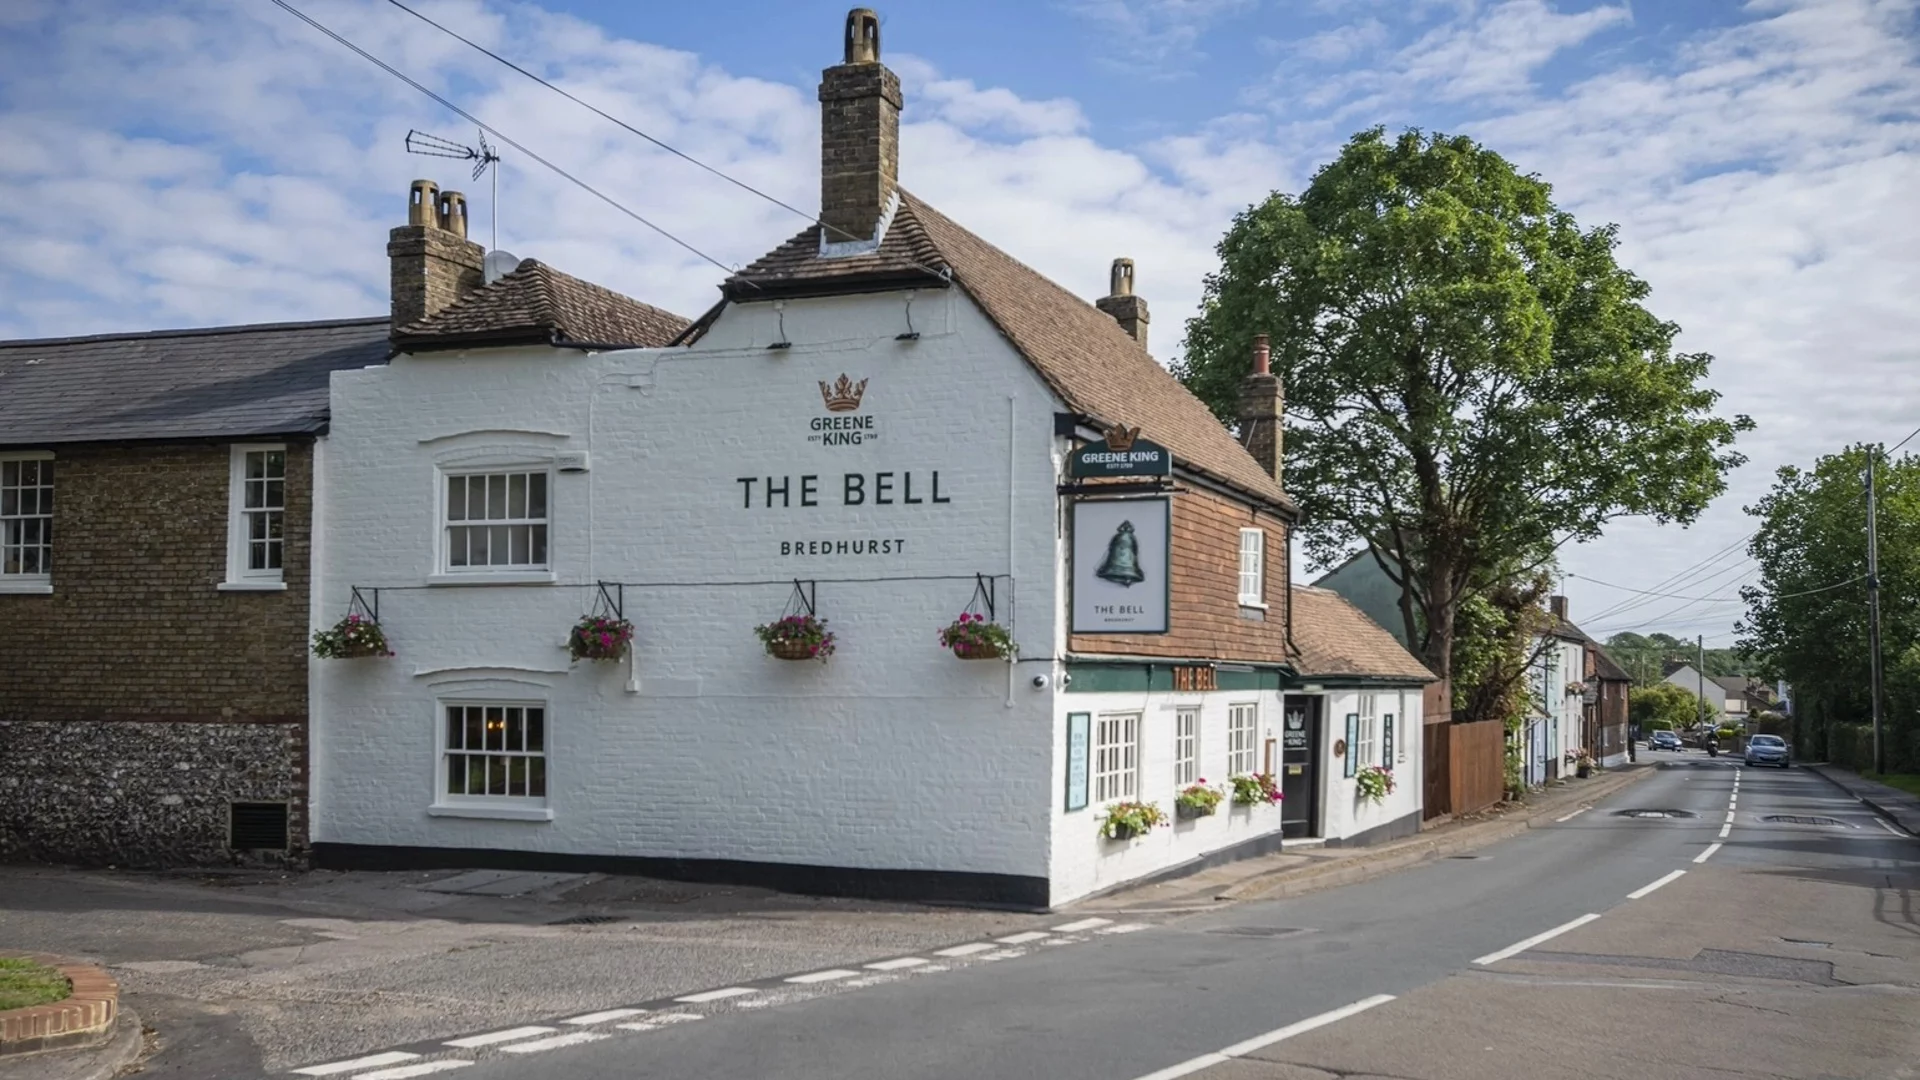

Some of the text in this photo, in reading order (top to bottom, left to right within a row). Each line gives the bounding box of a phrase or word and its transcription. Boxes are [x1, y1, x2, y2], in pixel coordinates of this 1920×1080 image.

[810, 415, 874, 431] GREENE
[823, 431, 862, 446] KING
[1082, 451, 1159, 463] GREENE KING
[737, 471, 951, 509] THE BELL
[781, 539, 905, 556] BREDHURST
[1094, 605, 1145, 614] THE BELL
[1174, 667, 1217, 690] THE BELL
